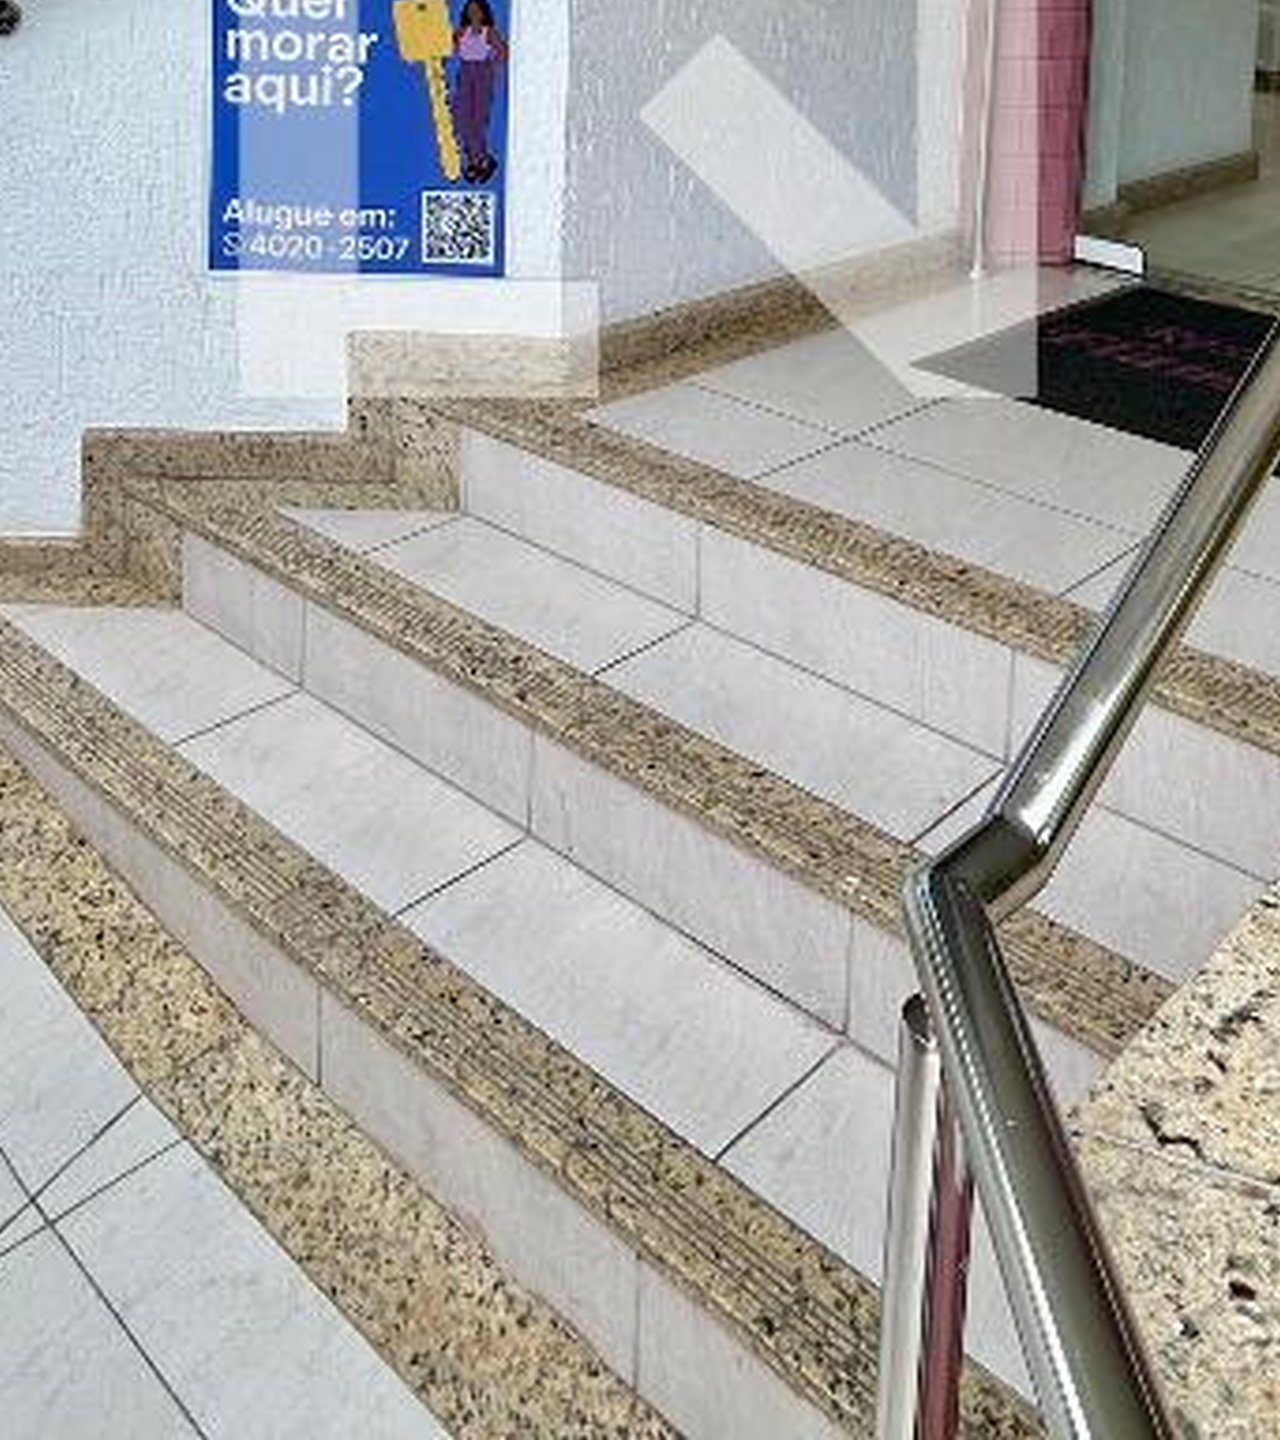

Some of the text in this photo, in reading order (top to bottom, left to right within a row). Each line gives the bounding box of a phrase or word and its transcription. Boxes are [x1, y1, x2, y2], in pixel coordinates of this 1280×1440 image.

[226, 30, 379, 65] morar
[224, 64, 363, 113] aqui?
[223, 198, 396, 230] Alugue em:
